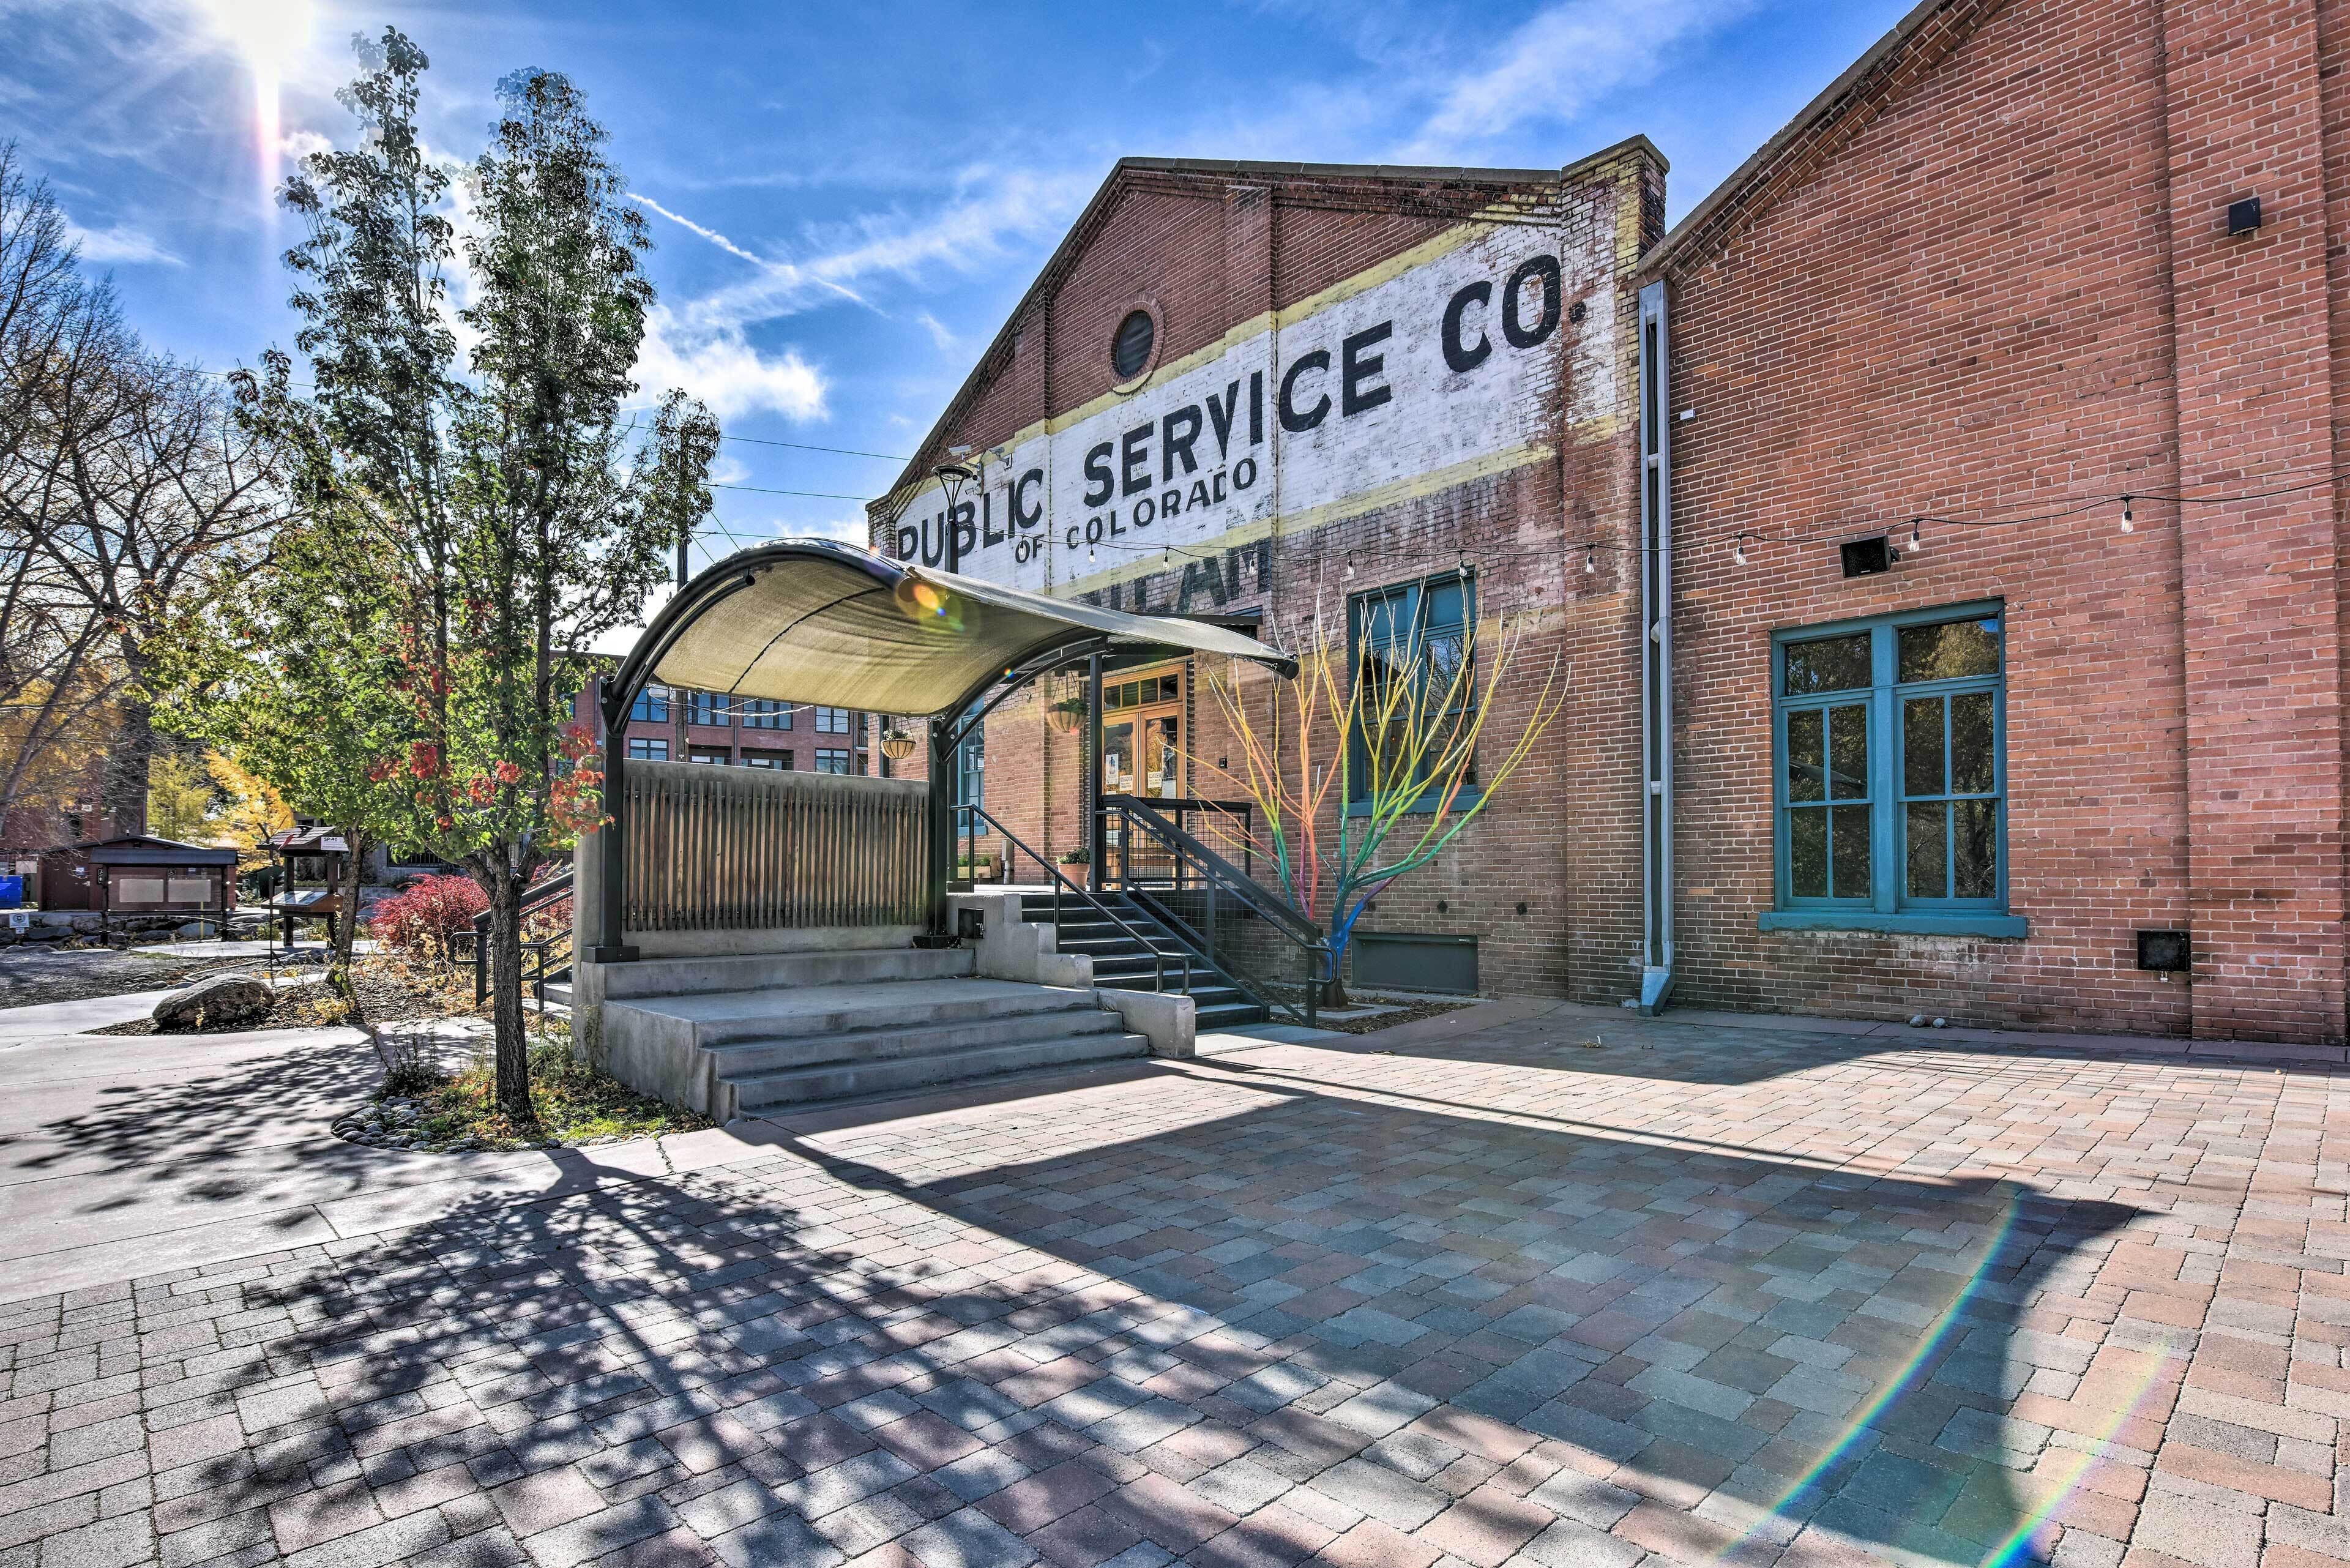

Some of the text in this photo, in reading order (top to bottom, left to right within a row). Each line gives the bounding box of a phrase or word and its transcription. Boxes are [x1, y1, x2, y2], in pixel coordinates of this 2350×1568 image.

[898, 468, 1043, 568] PUBLIC
[1083, 319, 1392, 508] SERVICE
[1015, 458, 1257, 563] OF COLORADO
